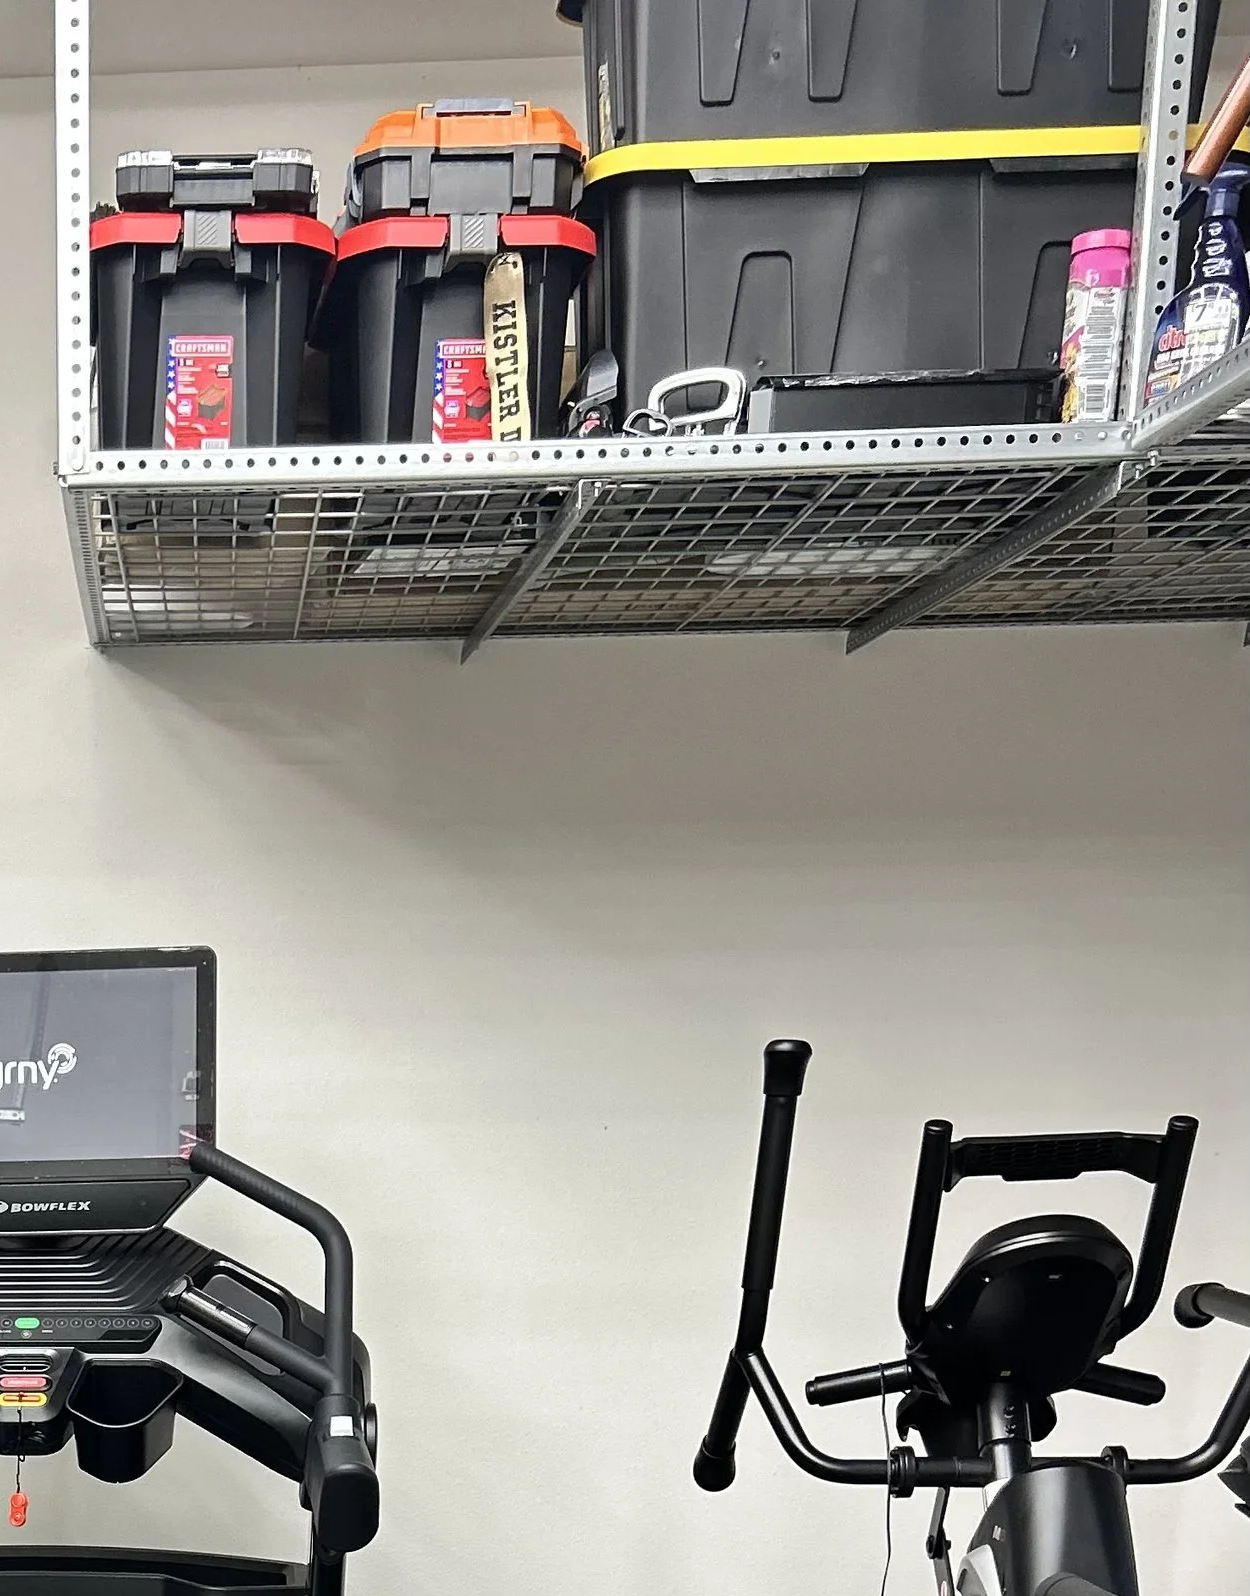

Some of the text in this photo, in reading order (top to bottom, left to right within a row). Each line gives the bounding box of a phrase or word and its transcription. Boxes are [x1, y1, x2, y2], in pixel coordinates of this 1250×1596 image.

[175, 343, 227, 353] CRAFTSMAN
[492, 300, 522, 422] KISTLER
[10, 1201, 91, 1214] BOWFLEX
